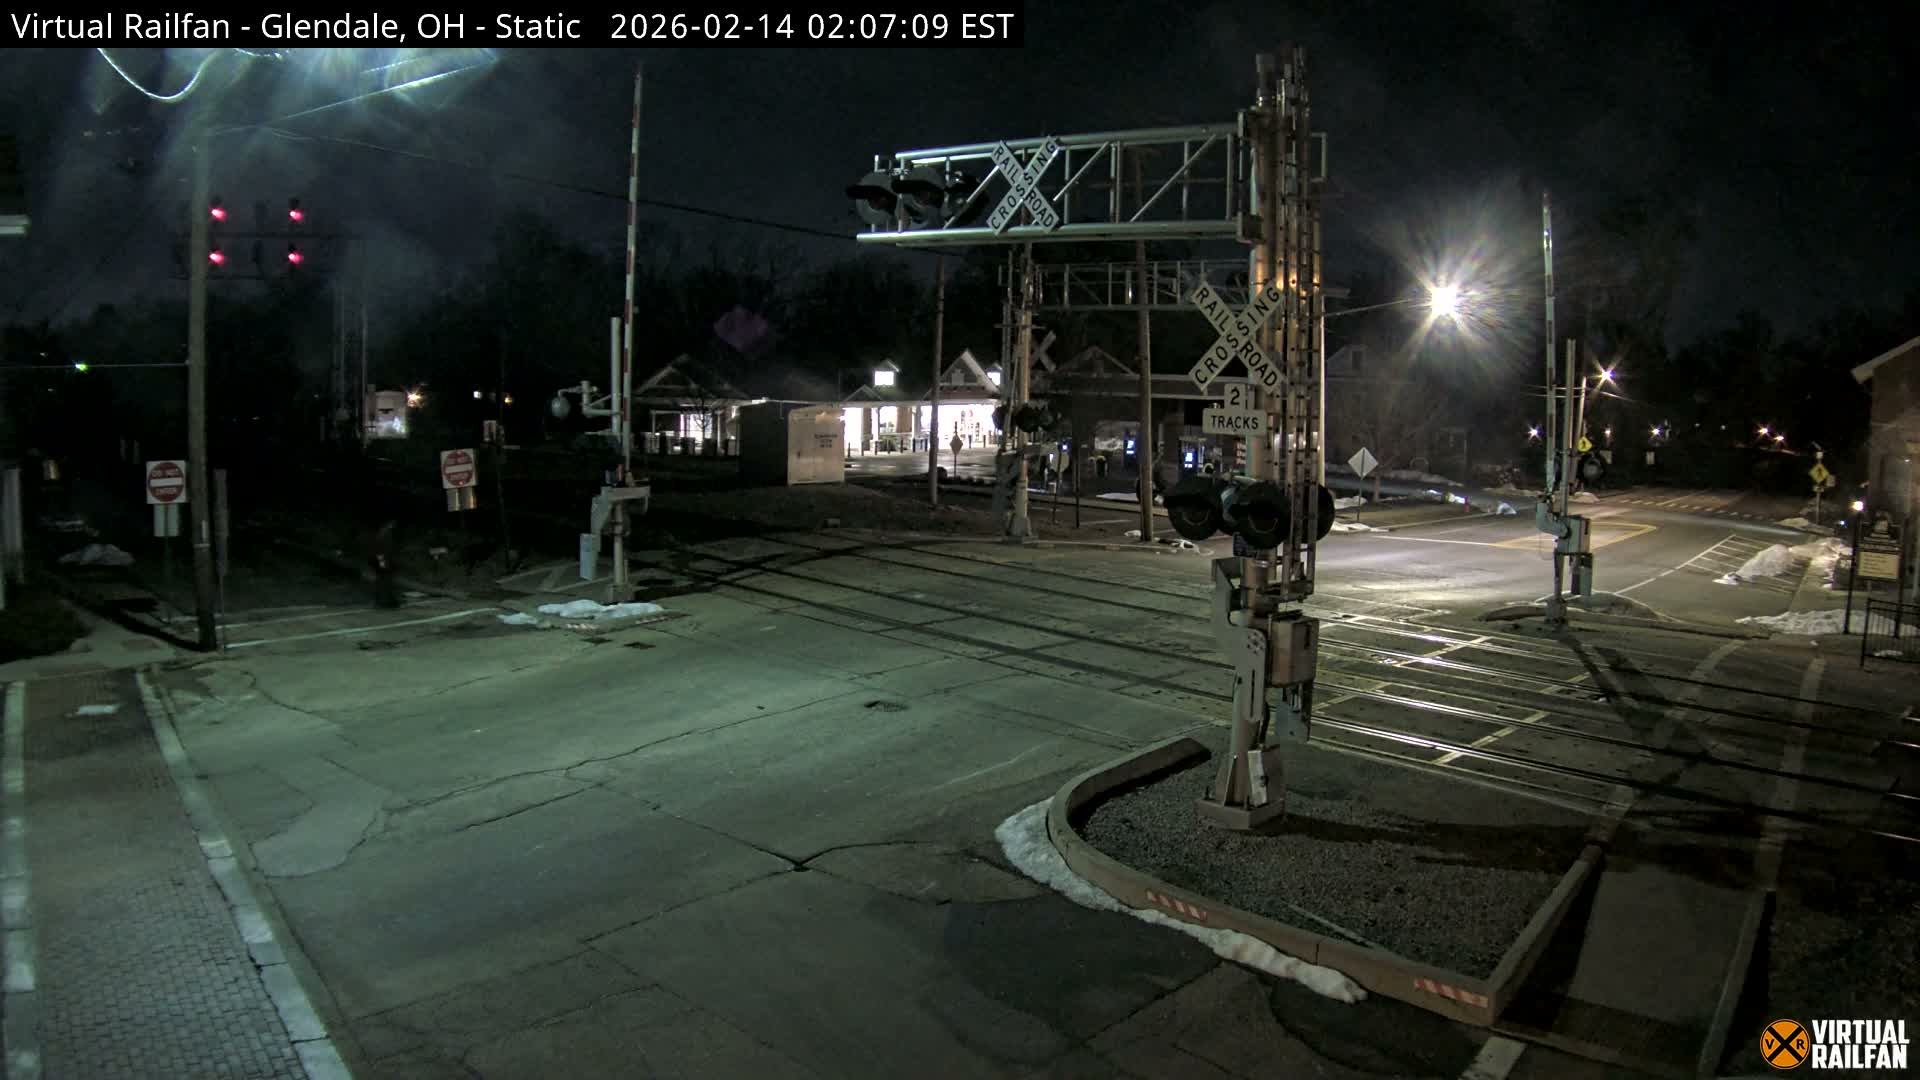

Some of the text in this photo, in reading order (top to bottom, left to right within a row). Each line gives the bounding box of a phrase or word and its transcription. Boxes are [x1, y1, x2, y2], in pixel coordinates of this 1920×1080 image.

[991, 141, 1056, 229] CROSSING
[1194, 287, 1280, 384] CROSSING
[1210, 415, 1259, 430] TRACKS
[1230, 386, 1240, 406] 2
